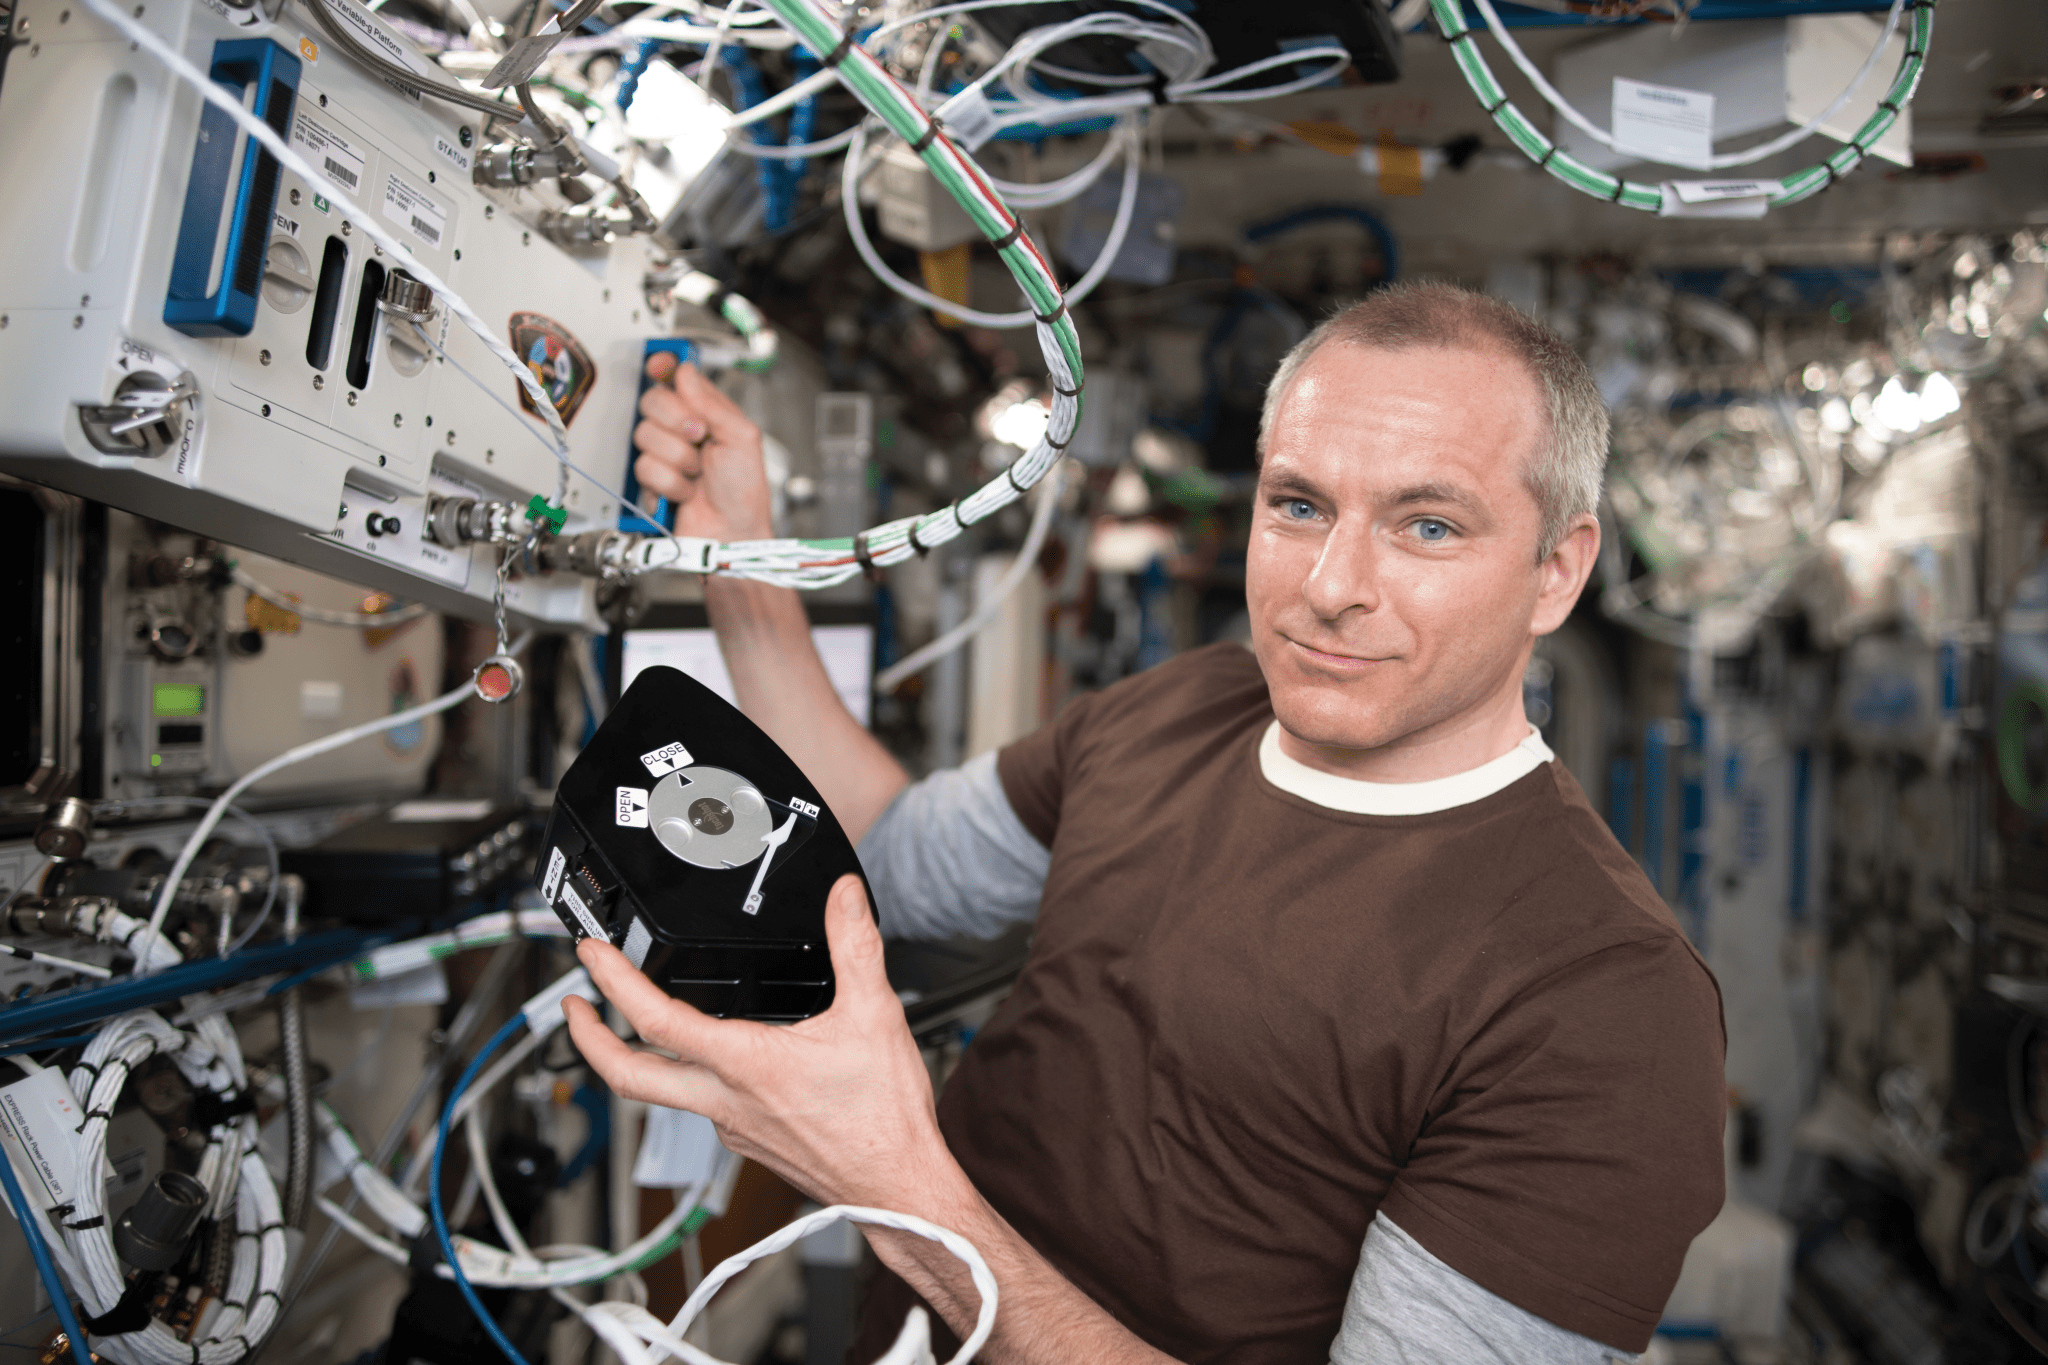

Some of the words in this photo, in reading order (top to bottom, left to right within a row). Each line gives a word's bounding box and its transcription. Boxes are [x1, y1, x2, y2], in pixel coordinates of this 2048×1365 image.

[337, 0, 372, 34] Variable-g
[373, 28, 403, 56] Platform
[296, 123, 306, 134] P/N
[299, 111, 308, 121] Left
[295, 131, 305, 142] S/N
[437, 140, 468, 168] STATUS
[121, 341, 155, 364] OPEN
[642, 743, 685, 766] CLOSE
[619, 790, 631, 823] OPEN
[697, 801, 725, 831] techshot
[550, 851, 563, 884] VENT
[568, 897, 580, 915] FOR
[579, 914, 600, 940] LAUNC
[570, 893, 582, 910] THIS
[582, 910, 595, 927] SIDE
[595, 926, 604, 939] UP
[4, 1093, 26, 1127] EXPRESS
[21, 1124, 34, 1143] Rack
[30, 1141, 44, 1161] Power
[40, 1160, 54, 1181] Cable
